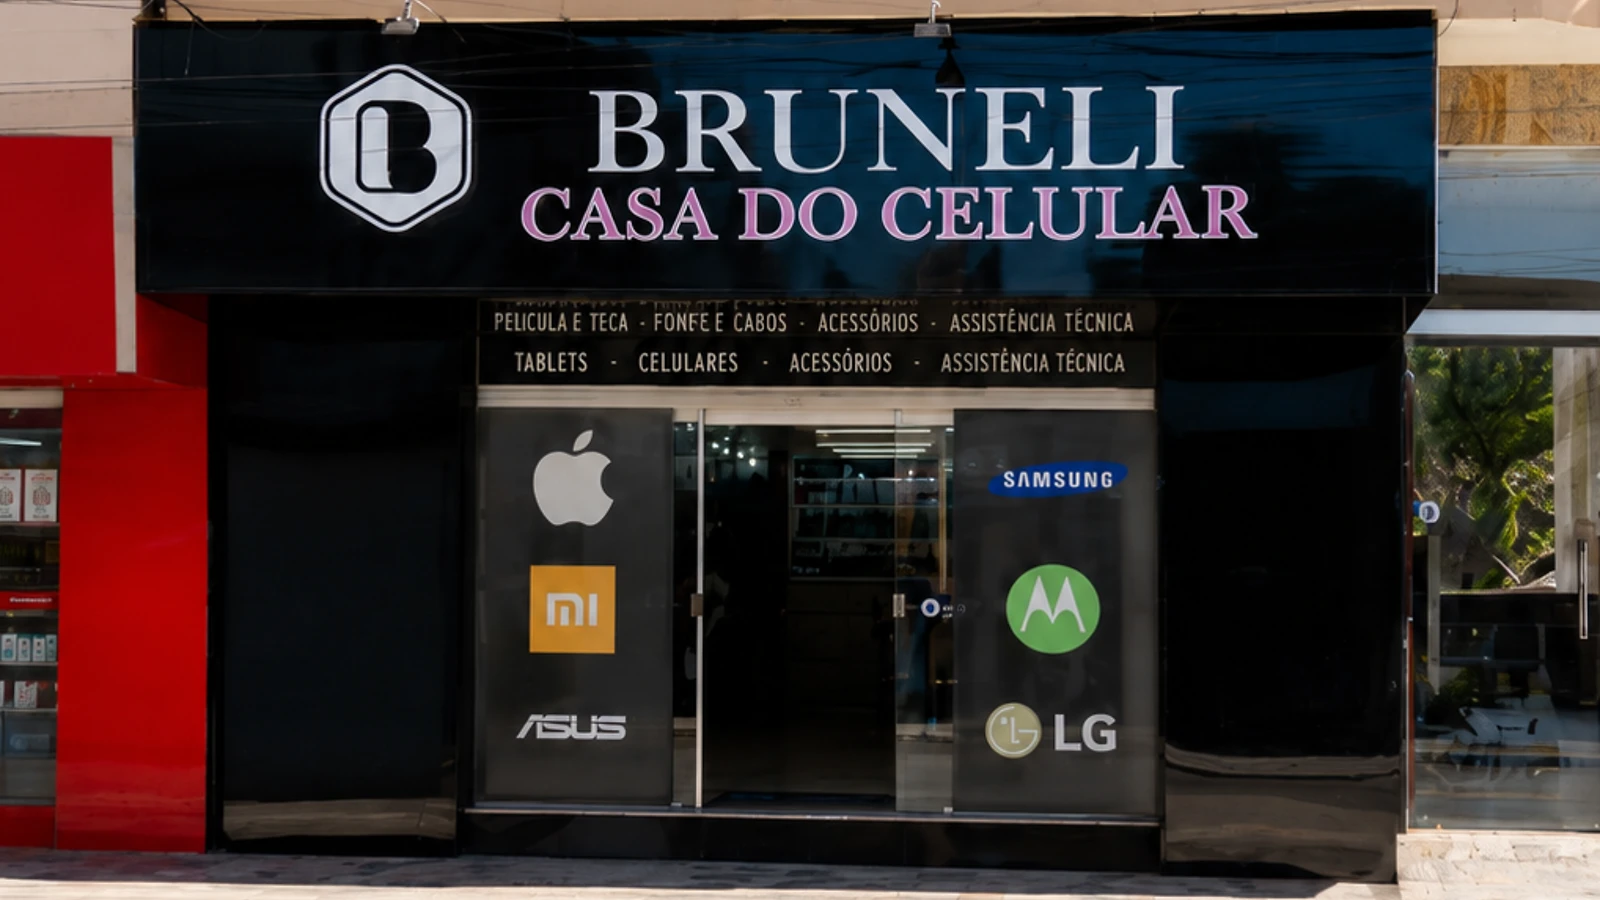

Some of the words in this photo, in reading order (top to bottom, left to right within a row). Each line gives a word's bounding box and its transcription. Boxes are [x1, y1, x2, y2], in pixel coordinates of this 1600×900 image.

[588, 85, 1185, 174] BRUNELI
[521, 186, 719, 242] CASA
[738, 186, 858, 242] DO
[881, 184, 1258, 242] CELULAR
[494, 312, 567, 332] PELICULA
[573, 312, 582, 332] E
[589, 312, 628, 332] TECA
[715, 312, 724, 332] E
[733, 312, 787, 332] CABOS
[818, 308, 919, 332] ACESSÓRIOS
[1064, 308, 1135, 332] TÉCNICA
[515, 352, 588, 373] TABLETS
[638, 352, 739, 373] CELULARES
[789, 348, 892, 373] ACESSÓRIOS
[1056, 348, 1126, 373] TÉCNICA
[1003, 470, 1113, 488] SAMSUNG
[516, 714, 627, 741] ASUS
[1054, 713, 1117, 752] LG
